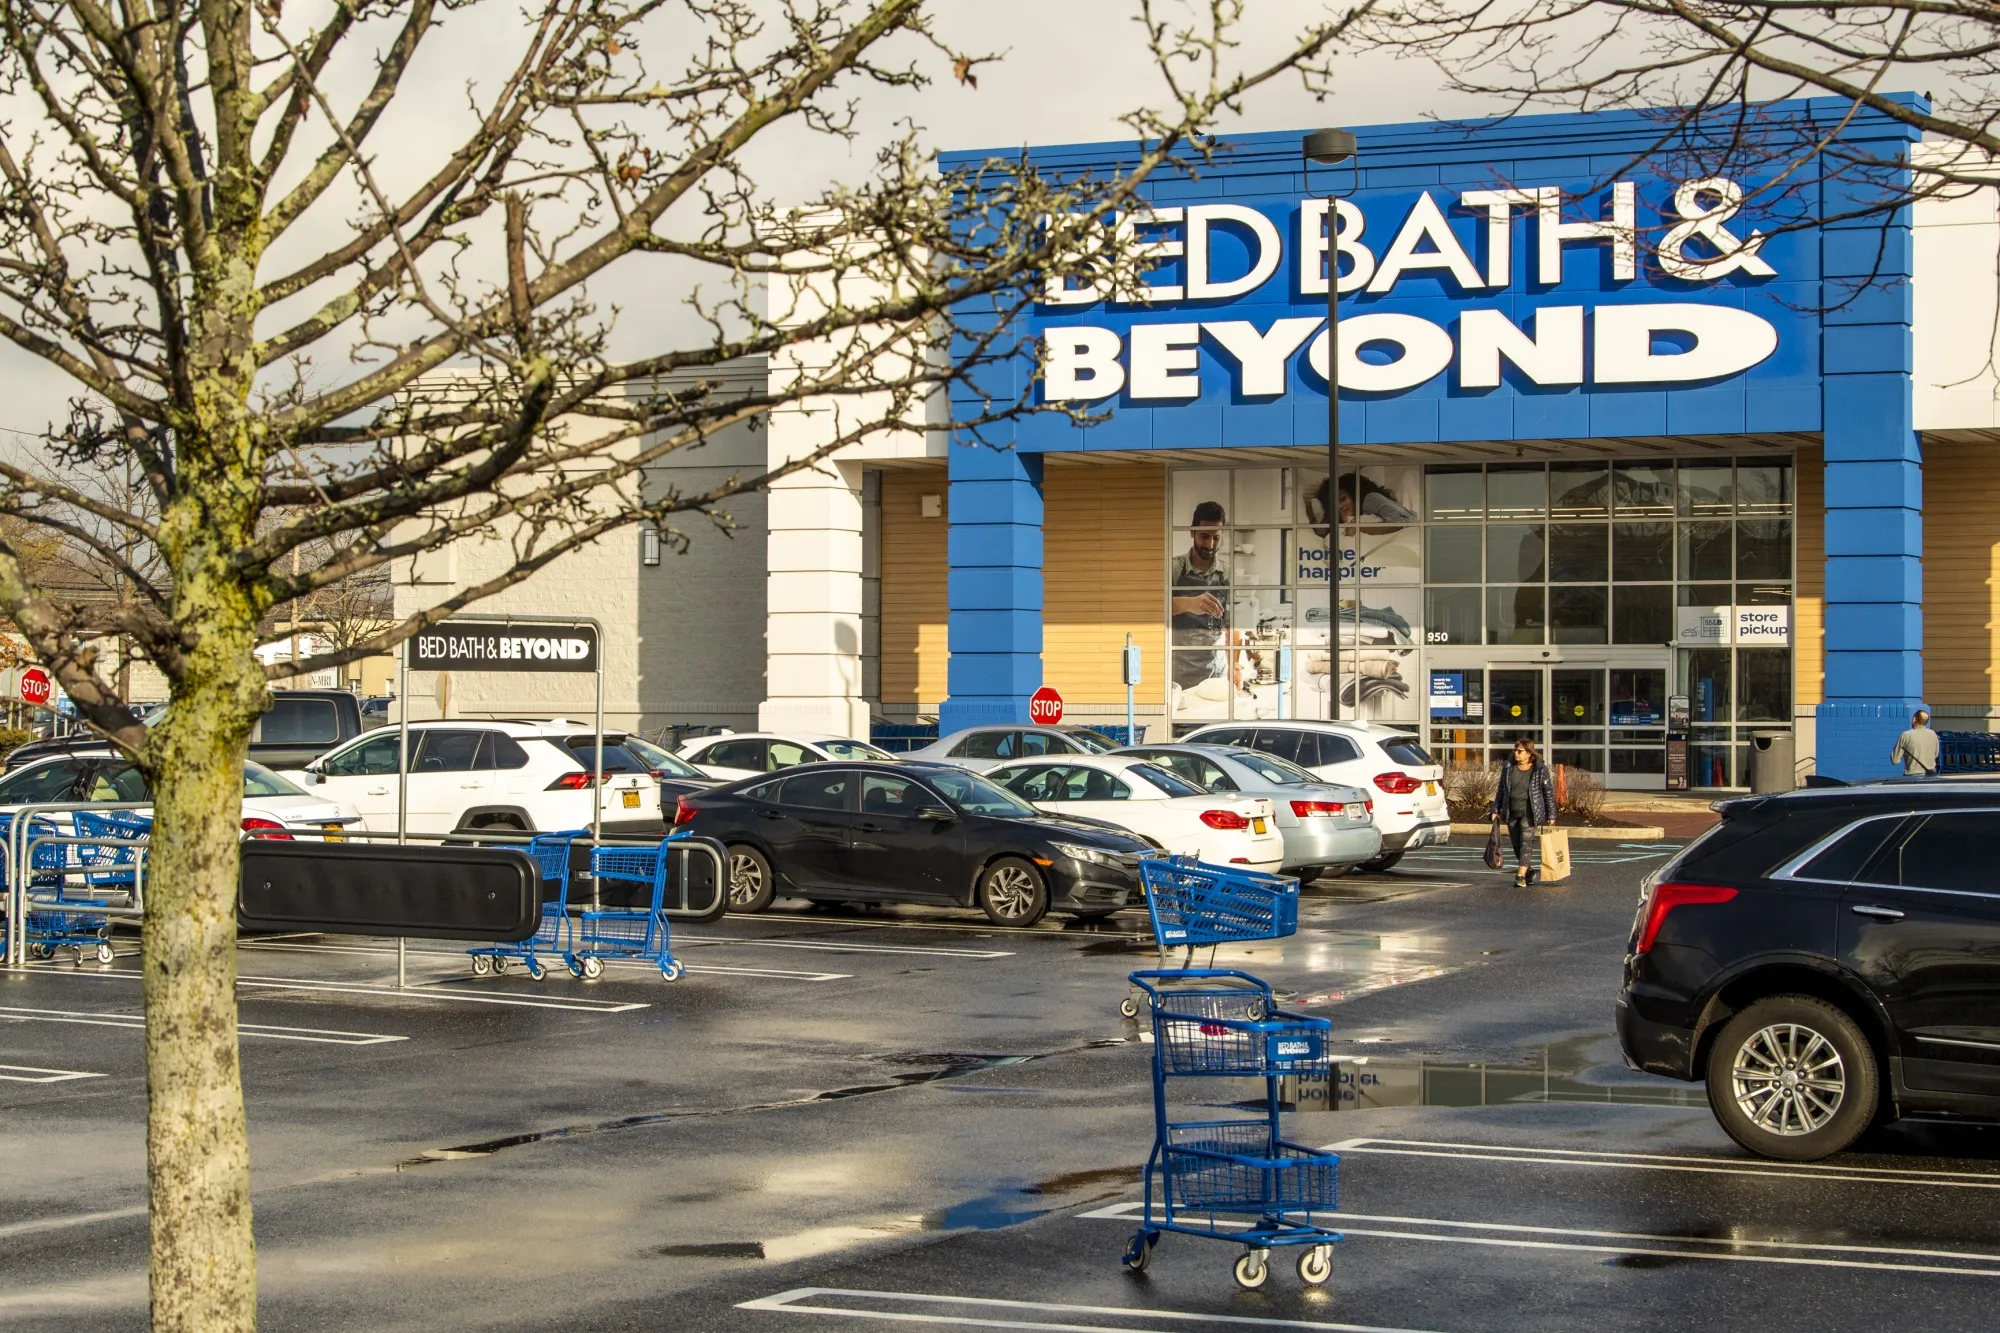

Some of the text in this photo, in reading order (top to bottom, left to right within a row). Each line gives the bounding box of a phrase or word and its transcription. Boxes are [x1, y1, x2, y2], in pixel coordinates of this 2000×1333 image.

[1045, 177, 1778, 305] BED BATH &
[1045, 304, 1778, 401] BEYOND
[1740, 612, 1778, 622] store
[1427, 632, 1449, 642] 950
[1740, 624, 1788, 636] pickup
[419, 636, 447, 659] BED
[450, 636, 484, 659] BATH
[487, 637, 498, 659] &
[22, 678, 49, 697] STOP
[1032, 699, 1061, 717] STOP
